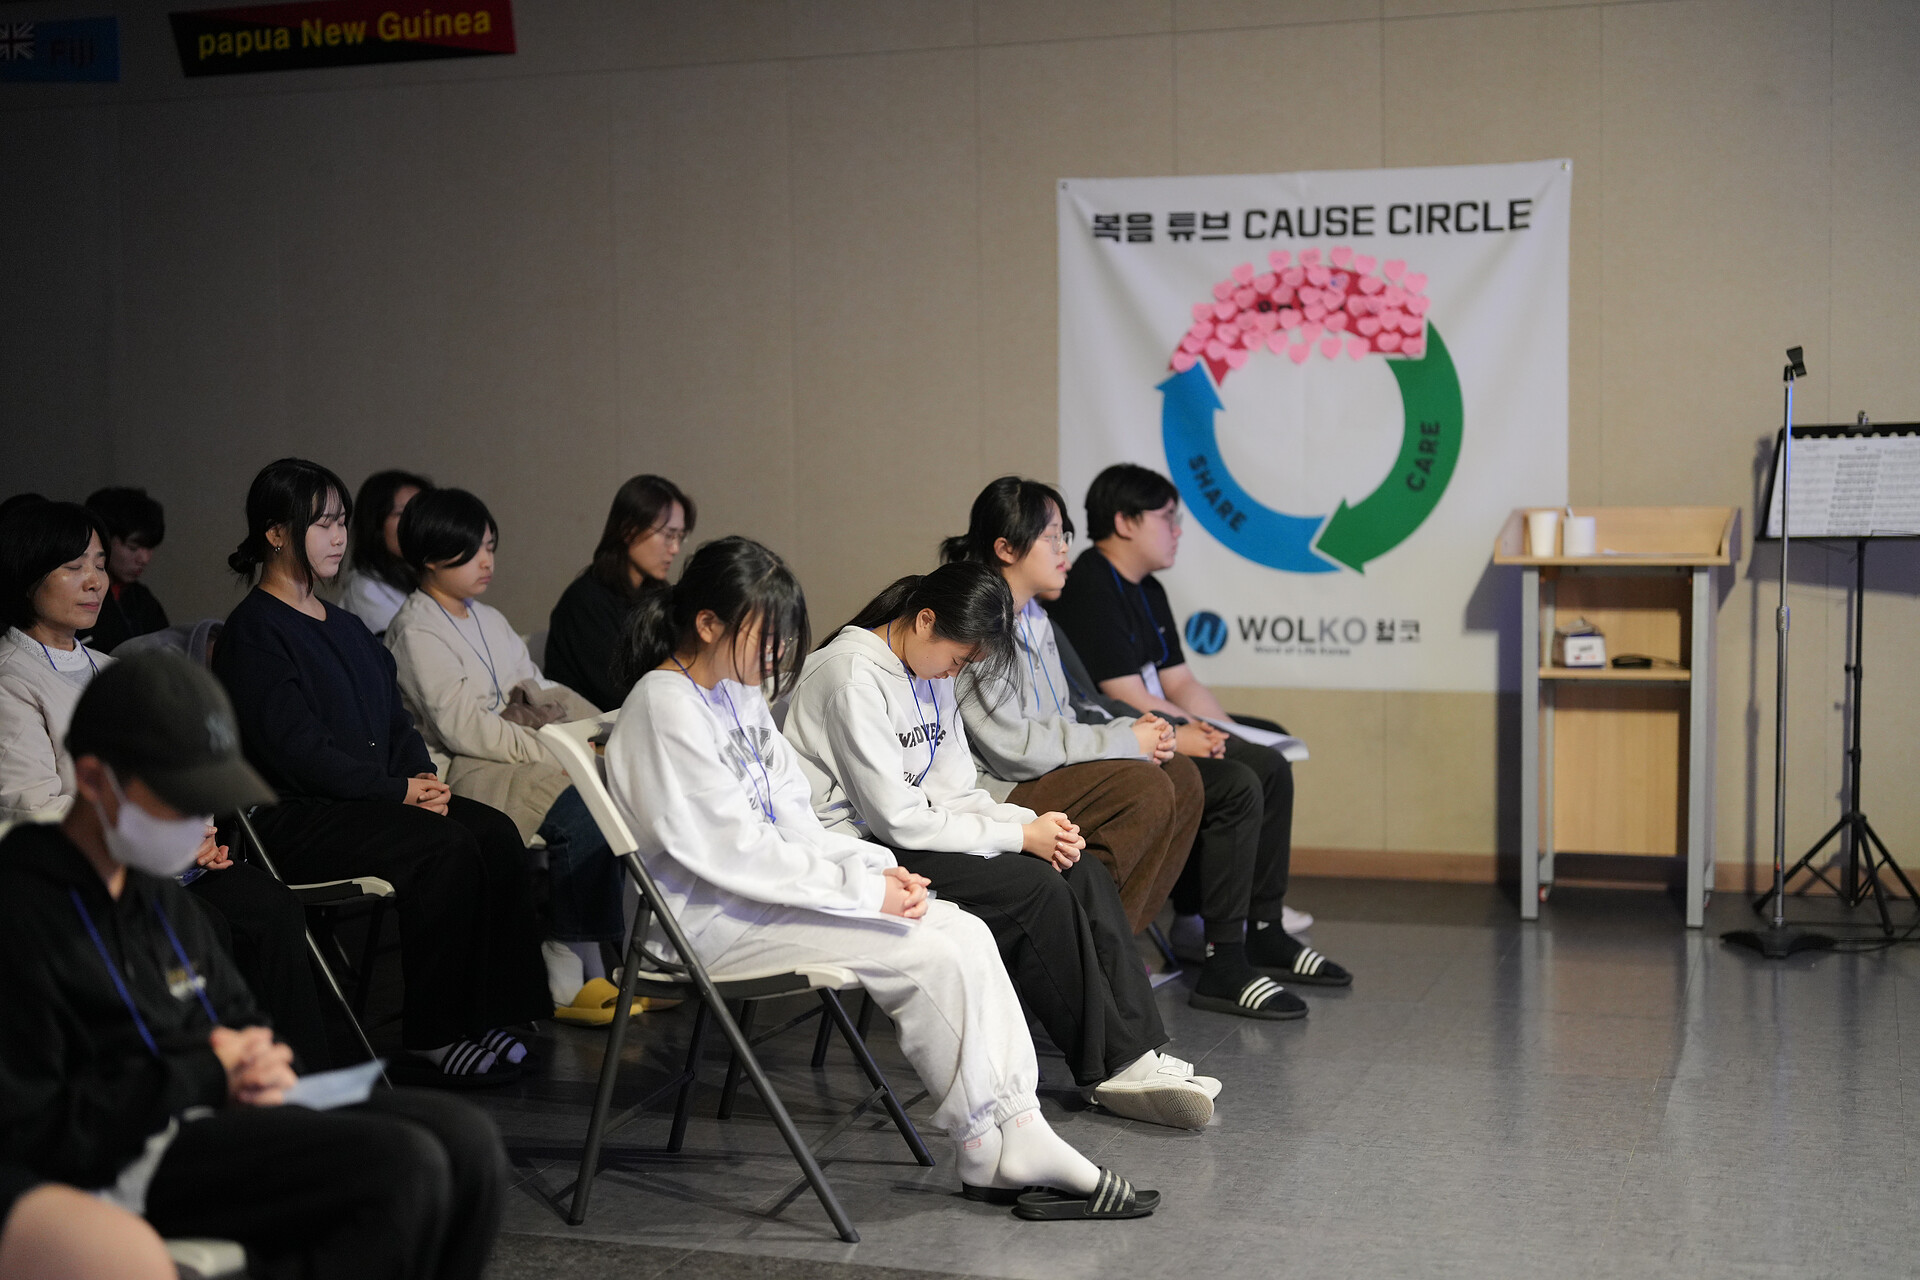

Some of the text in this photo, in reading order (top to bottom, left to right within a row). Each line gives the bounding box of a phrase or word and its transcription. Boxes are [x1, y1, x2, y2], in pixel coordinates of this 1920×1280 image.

[198, 9, 492, 60] papua New Guinea
[1094, 213, 1152, 243] 복음
[1244, 205, 1375, 240] CAUSE
[1388, 199, 1533, 236] CIRCLE
[1406, 421, 1440, 492] CARE
[1189, 455, 1247, 533] SHARE
[1237, 616, 1367, 645] WOLKO
